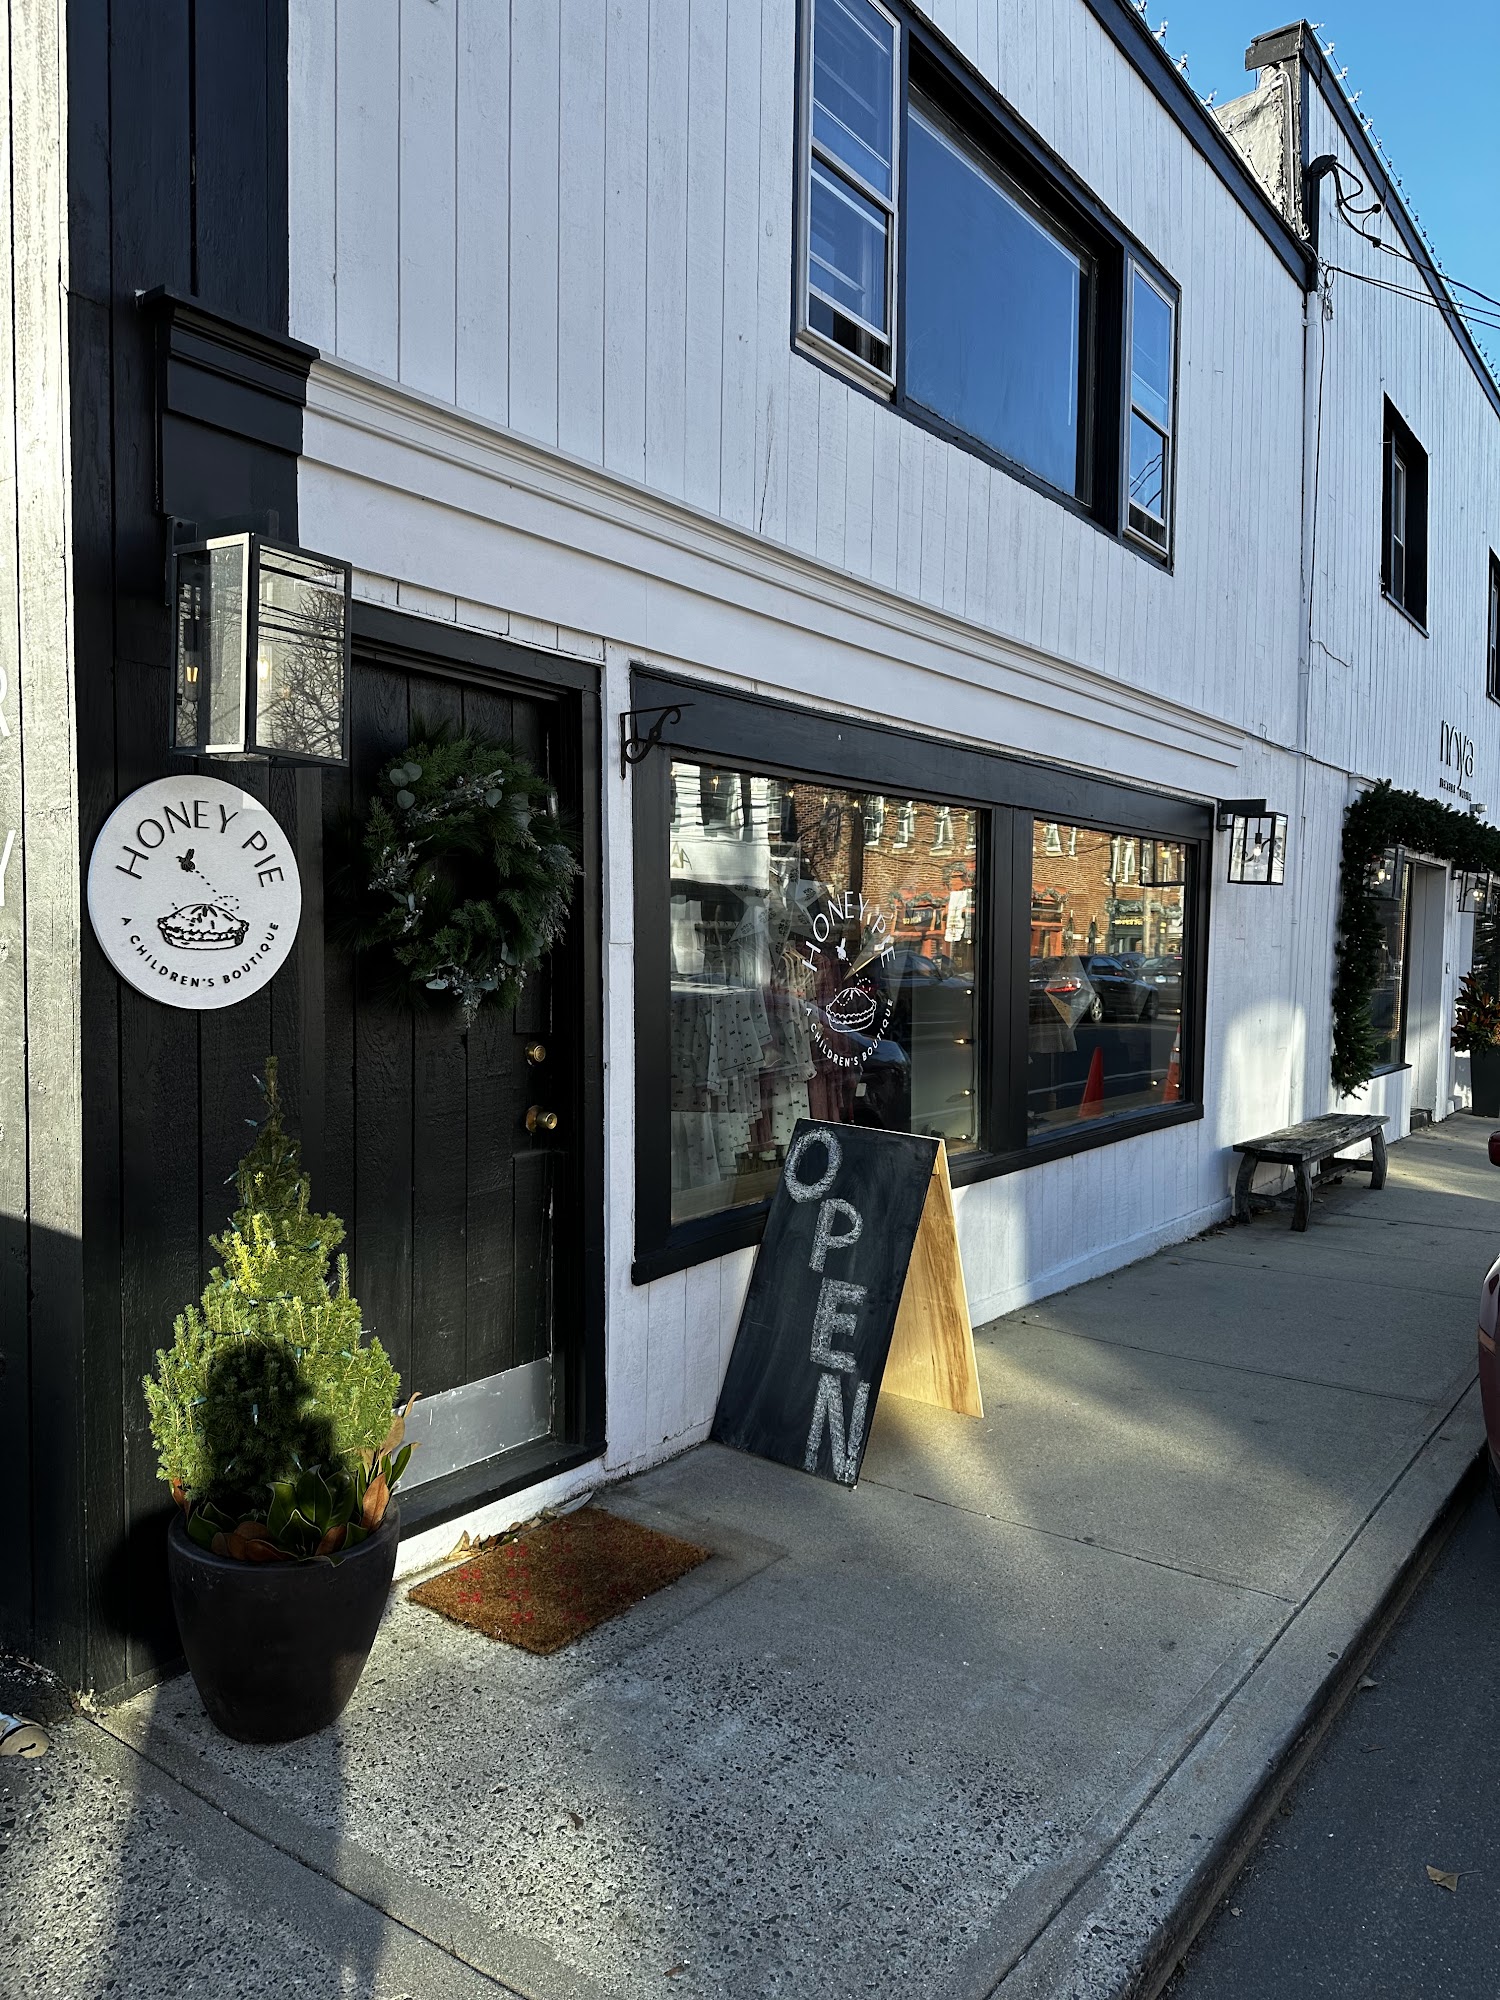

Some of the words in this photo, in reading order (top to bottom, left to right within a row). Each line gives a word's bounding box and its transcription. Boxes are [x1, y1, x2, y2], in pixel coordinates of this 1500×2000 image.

[115, 800, 239, 880] HONEY
[241, 830, 285, 888] PIE
[121, 916, 132, 926] A
[130, 934, 215, 988] CHILDREN'S
[222, 922, 279, 985] BOUTIQUE
[802, 891, 870, 972] HONEY
[871, 913, 896, 969] PIE
[810, 1023, 859, 1067] CHILDREN'S
[862, 998, 894, 1062] BOUTIQUE
[784, 1126, 872, 1485] OPEN
